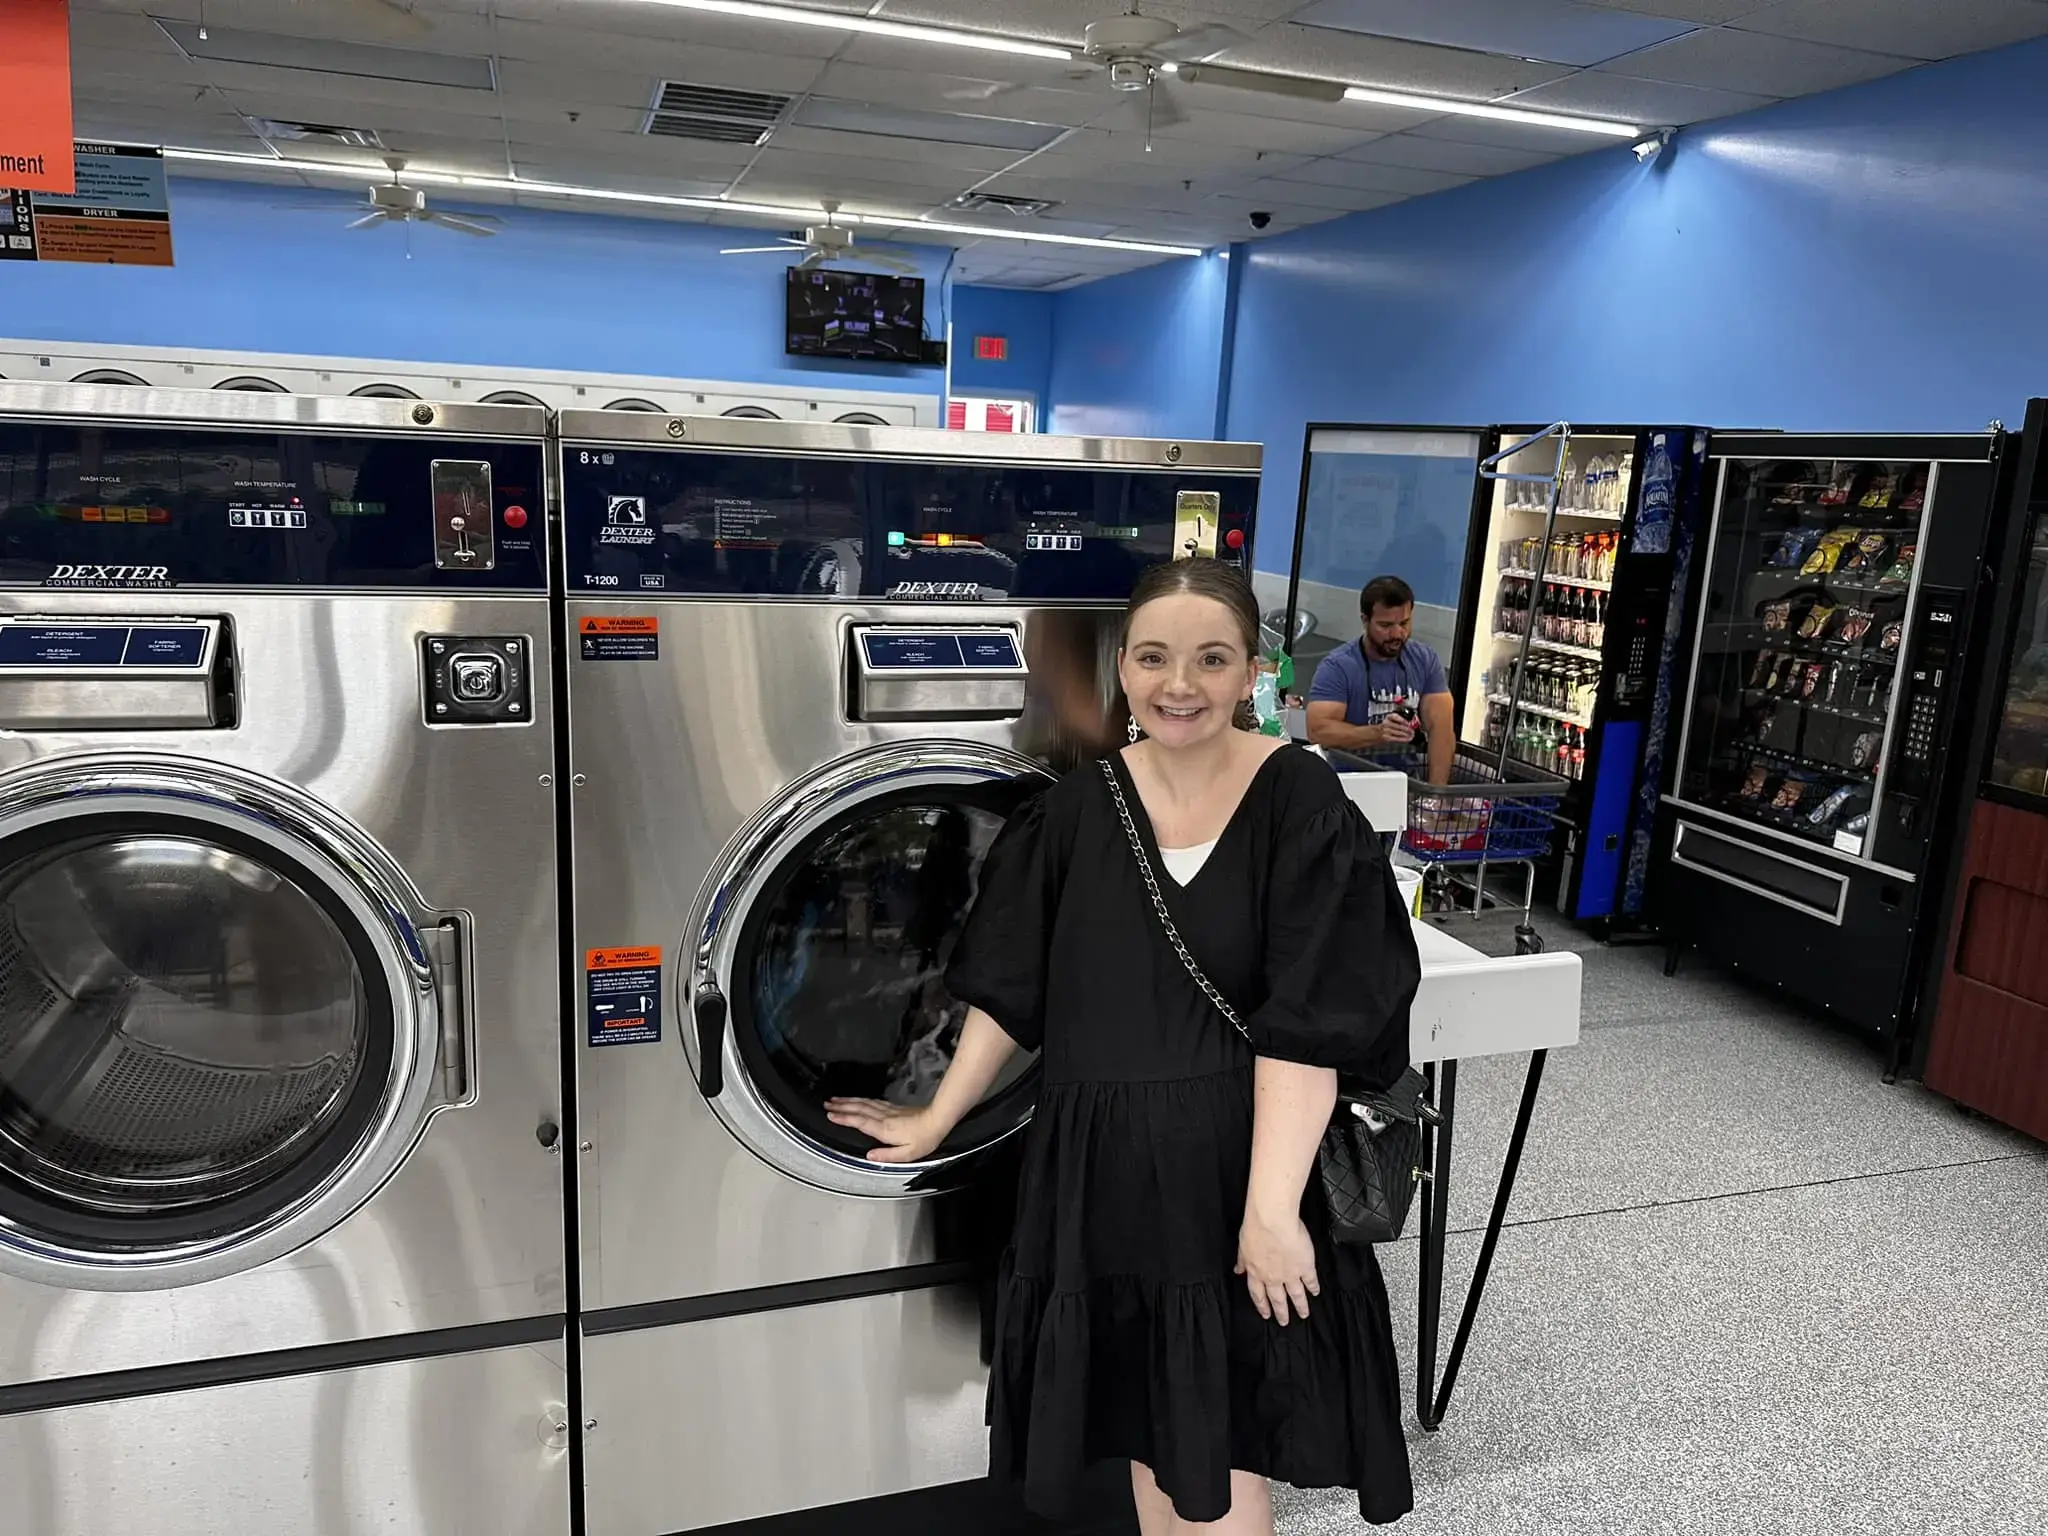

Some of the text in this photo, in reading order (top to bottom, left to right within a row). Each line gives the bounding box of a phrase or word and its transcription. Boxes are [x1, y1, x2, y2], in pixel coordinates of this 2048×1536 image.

[83, 208, 118, 218] DRYER
[580, 451, 599, 464] 8 x
[600, 527, 654, 537] DEXTER
[600, 536, 656, 545] LAUNDRY
[49, 565, 169, 580] DEXTER
[46, 579, 172, 588] COMMERCIAL WASHER
[584, 575, 619, 586] T-1200
[894, 581, 979, 595] DEXTER
